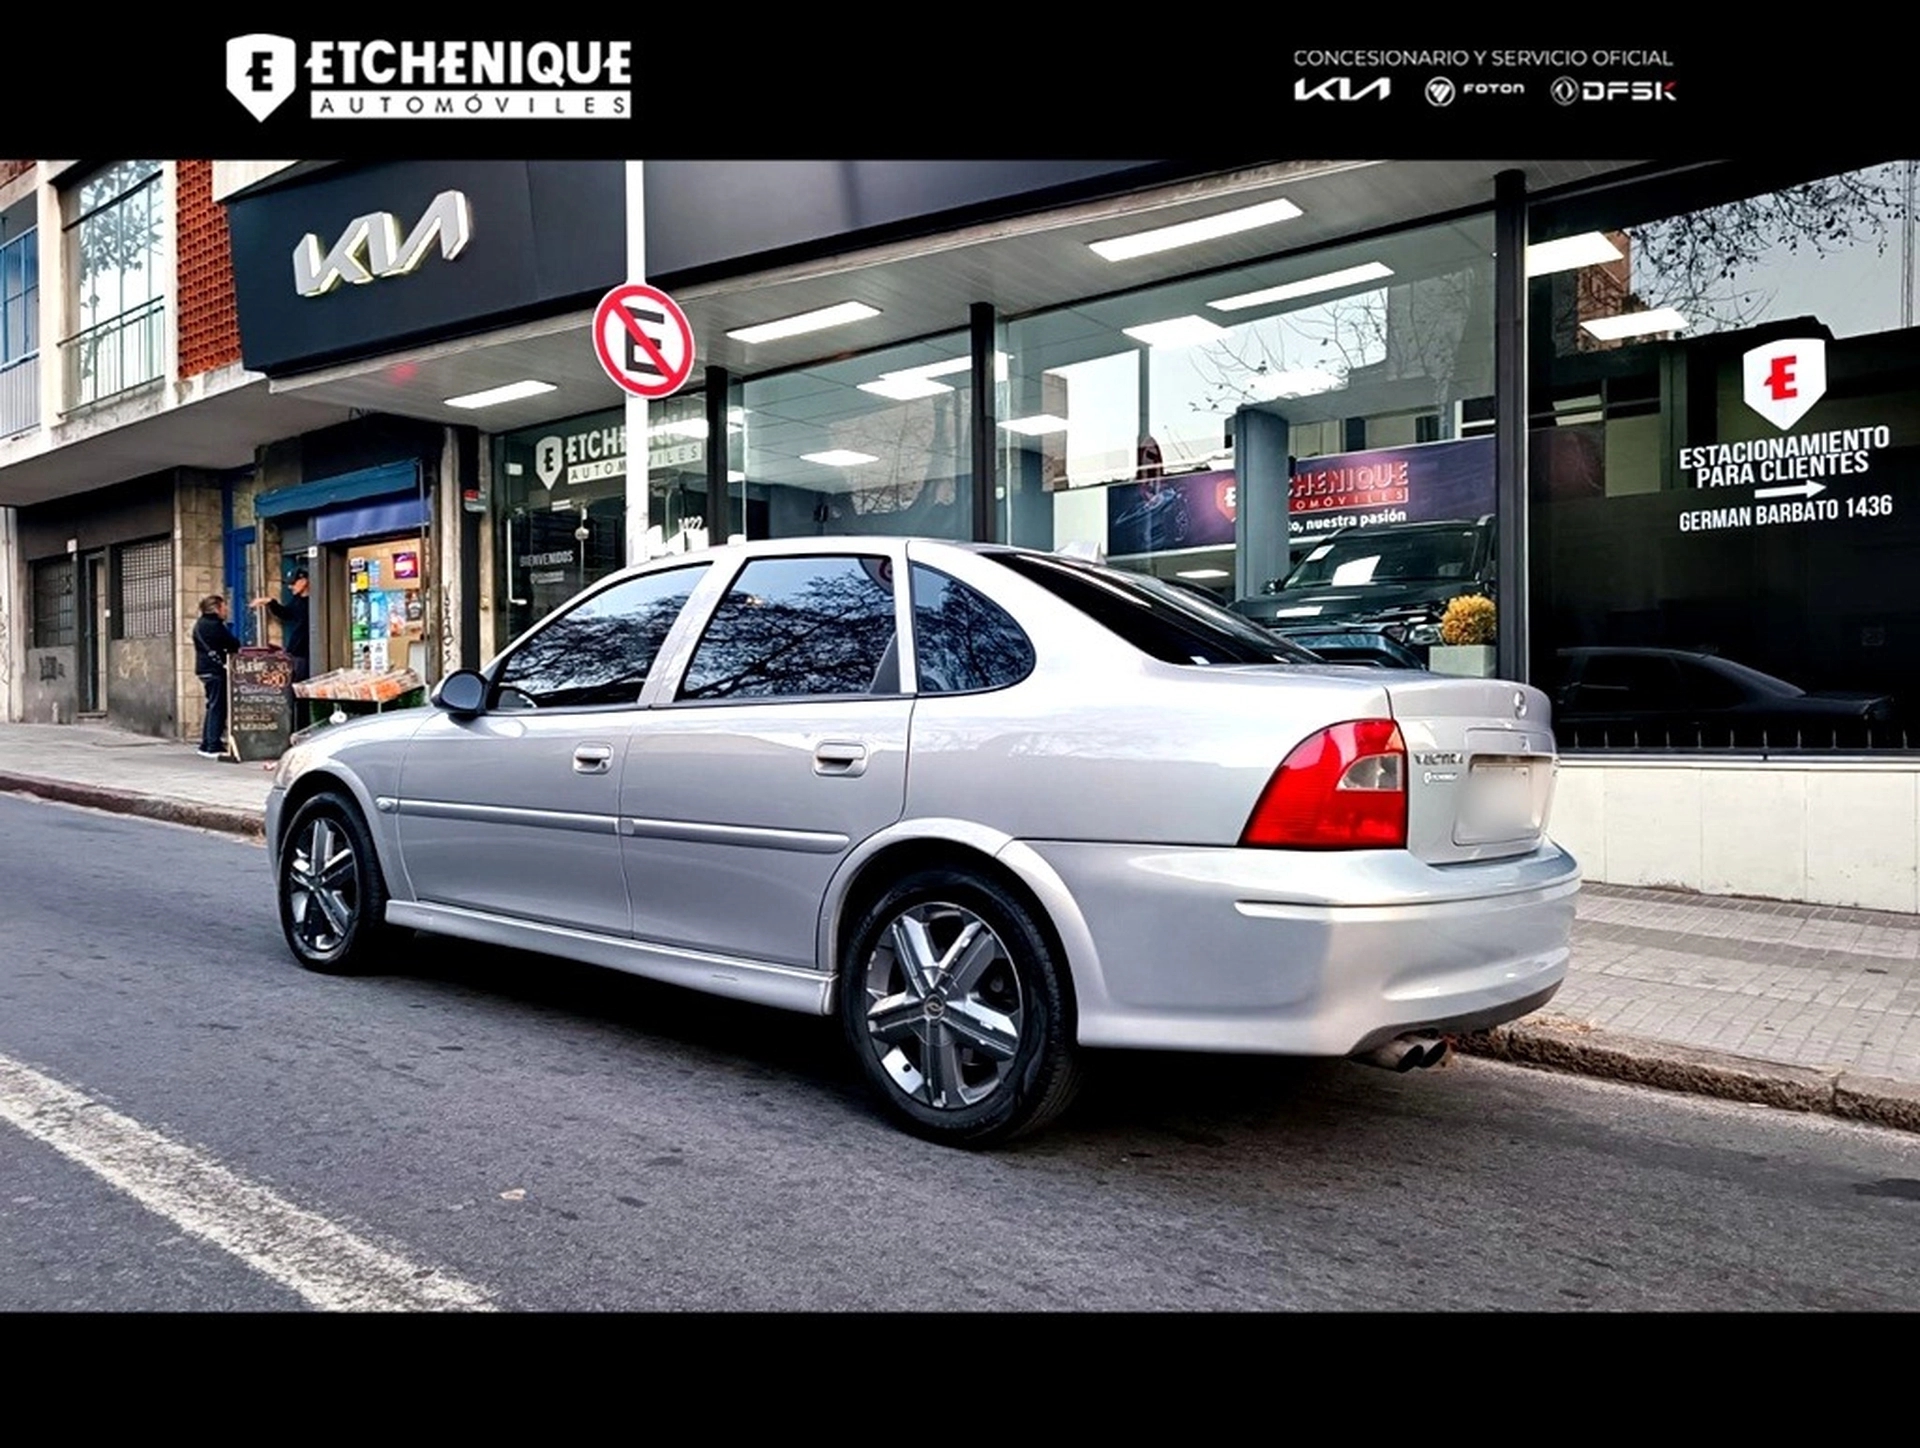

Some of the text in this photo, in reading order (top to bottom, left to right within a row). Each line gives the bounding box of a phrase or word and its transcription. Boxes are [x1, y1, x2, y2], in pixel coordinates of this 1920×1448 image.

[293, 189, 471, 297] KIA
[625, 306, 664, 375] E
[1680, 425, 1890, 470] ESTACIONAMIENTO
[1697, 450, 1869, 489] PARA CLIENTES
[1306, 515, 1357, 531] nuestra
[1360, 509, 1406, 528] pasión
[1679, 494, 1893, 532] GERMAN BARBATO 1436
